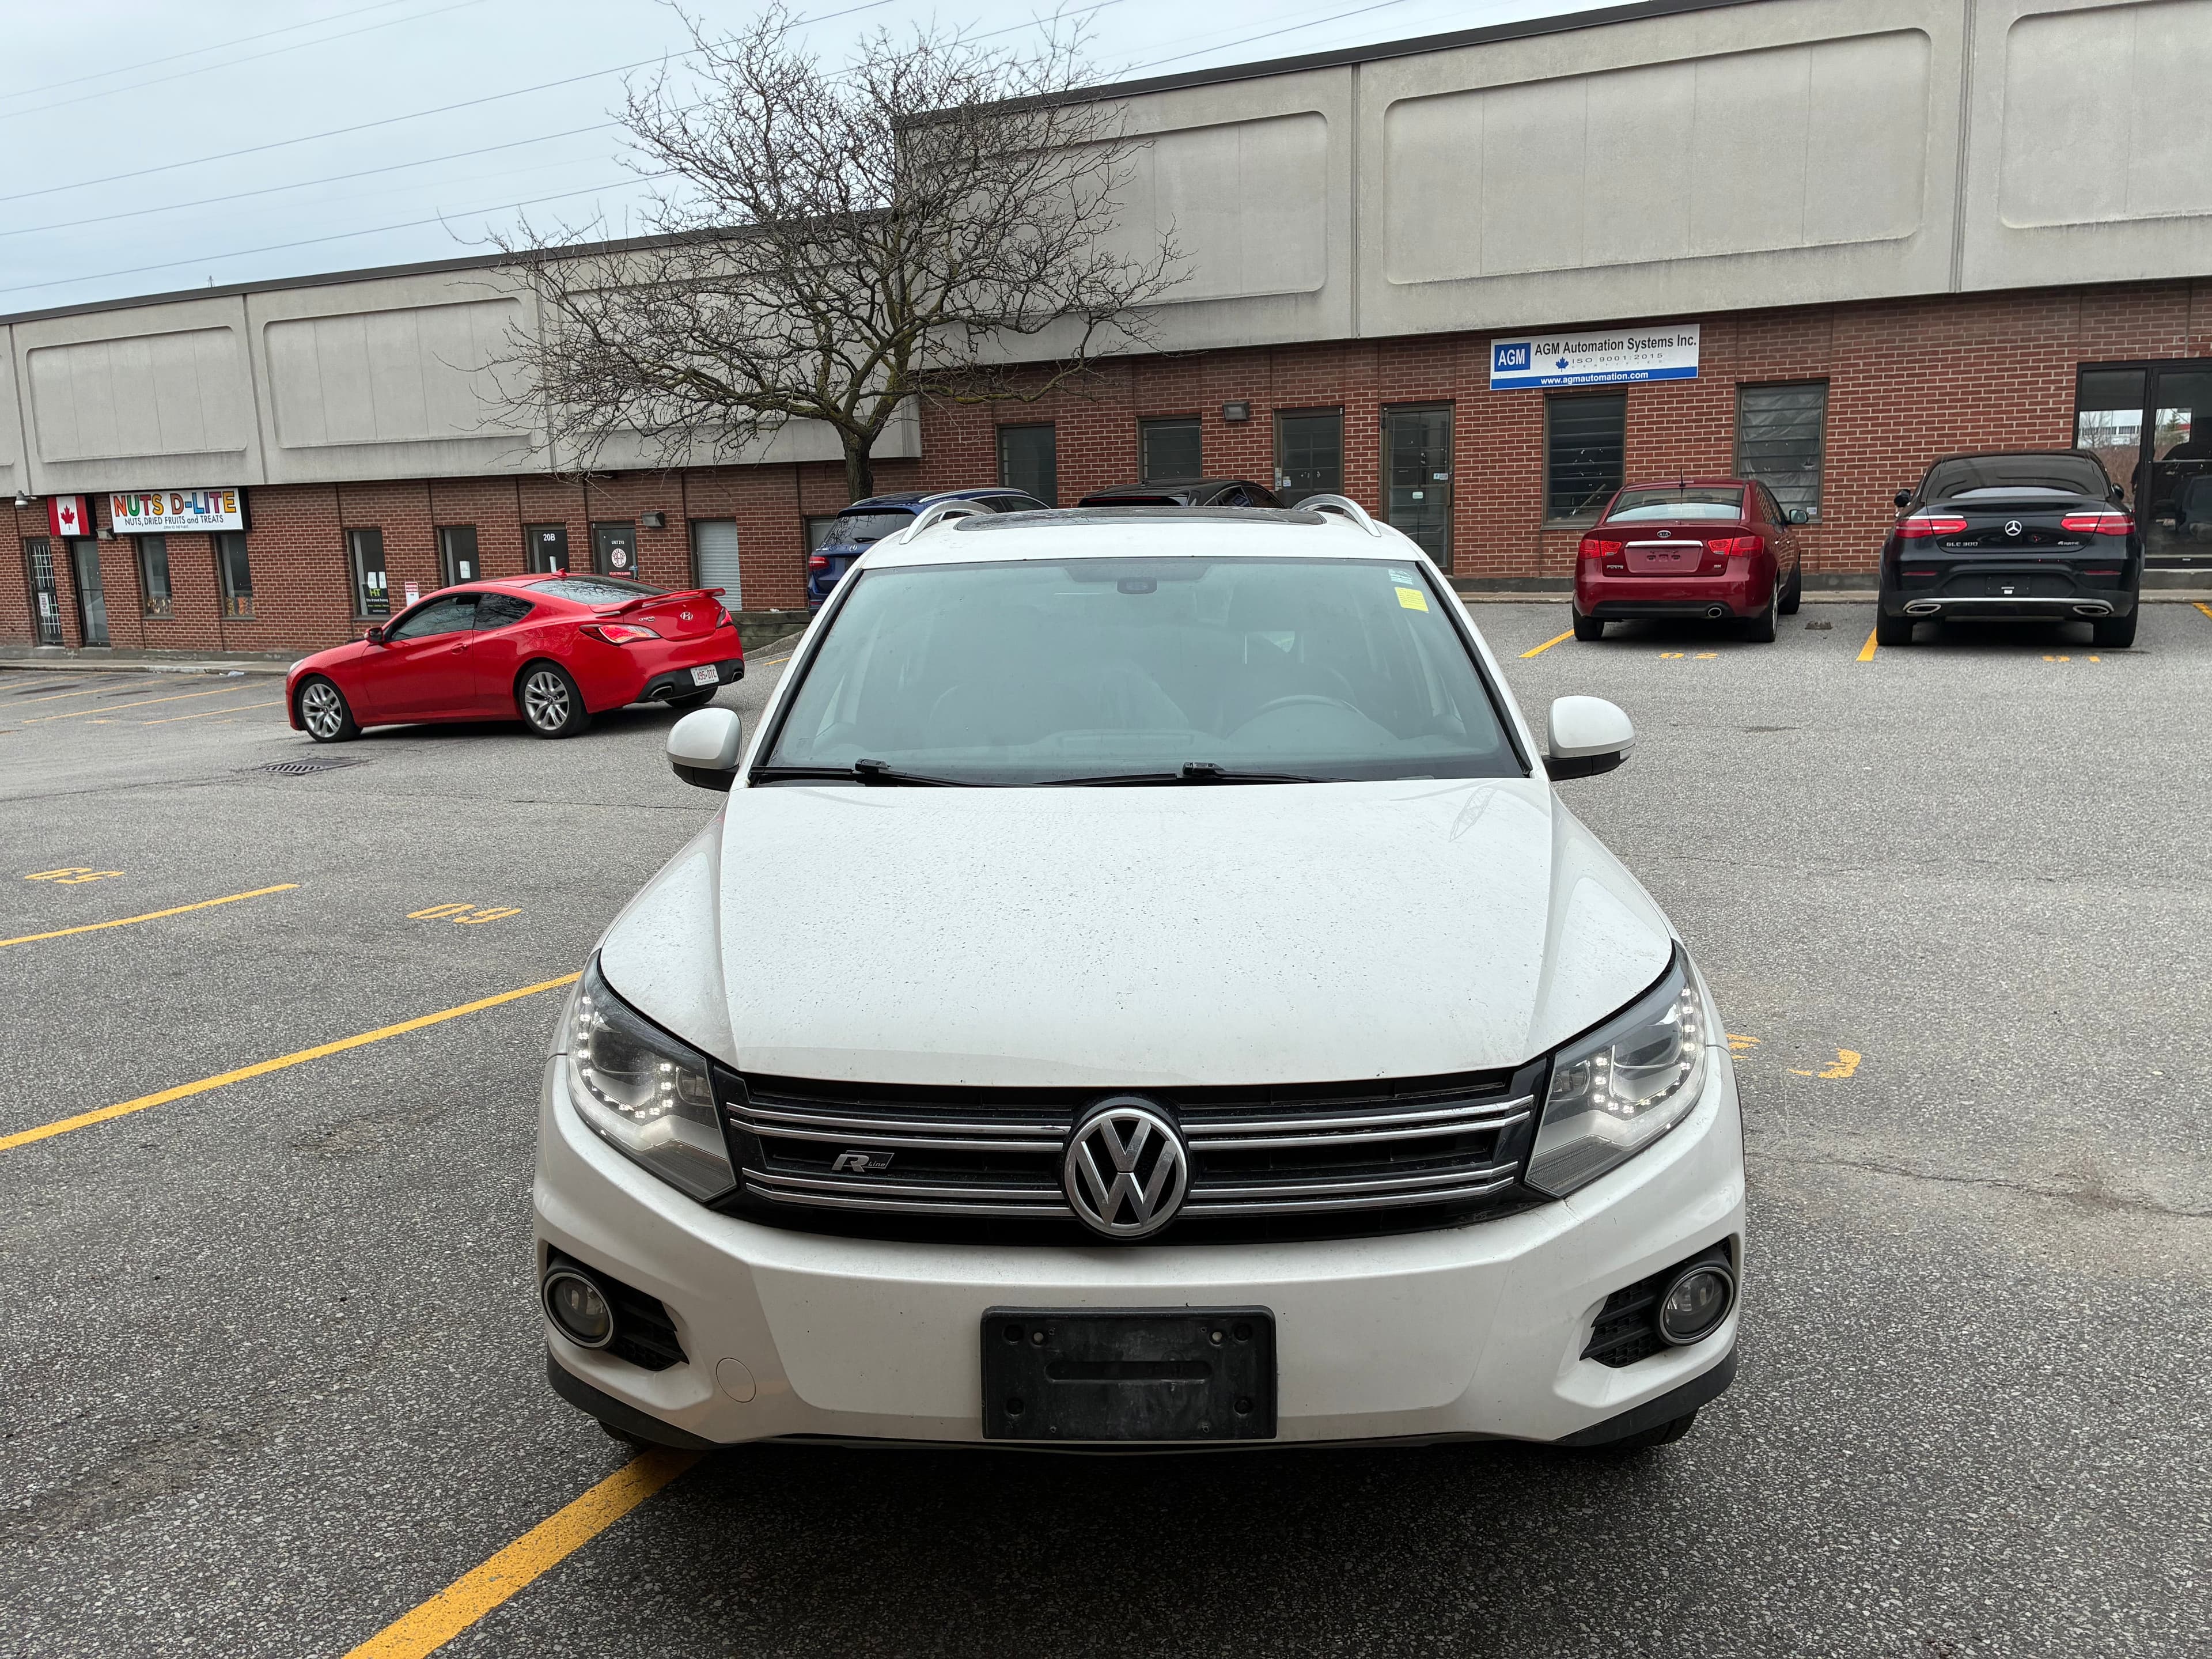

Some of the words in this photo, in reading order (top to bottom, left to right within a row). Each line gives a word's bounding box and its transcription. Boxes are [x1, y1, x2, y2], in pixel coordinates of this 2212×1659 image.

[1535, 342, 1560, 356] AGM
[1563, 338, 1623, 354] Automation
[1627, 336, 1673, 353] Systems
[1677, 334, 1697, 346] Inc.
[1498, 349, 1525, 366] AGM
[1599, 353, 1663, 362] 9001:2015
[1540, 372, 1649, 385] www.agmautomation.com
[113, 493, 164, 517] NUTS
[169, 491, 237, 515] D-LITE
[124, 517, 144, 527] NUTS,
[144, 516, 162, 525] DRIED
[165, 516, 185, 524] FRUITS
[187, 516, 199, 524] and
[201, 514, 224, 524] TREATS
[831, 1154, 869, 1172] R
